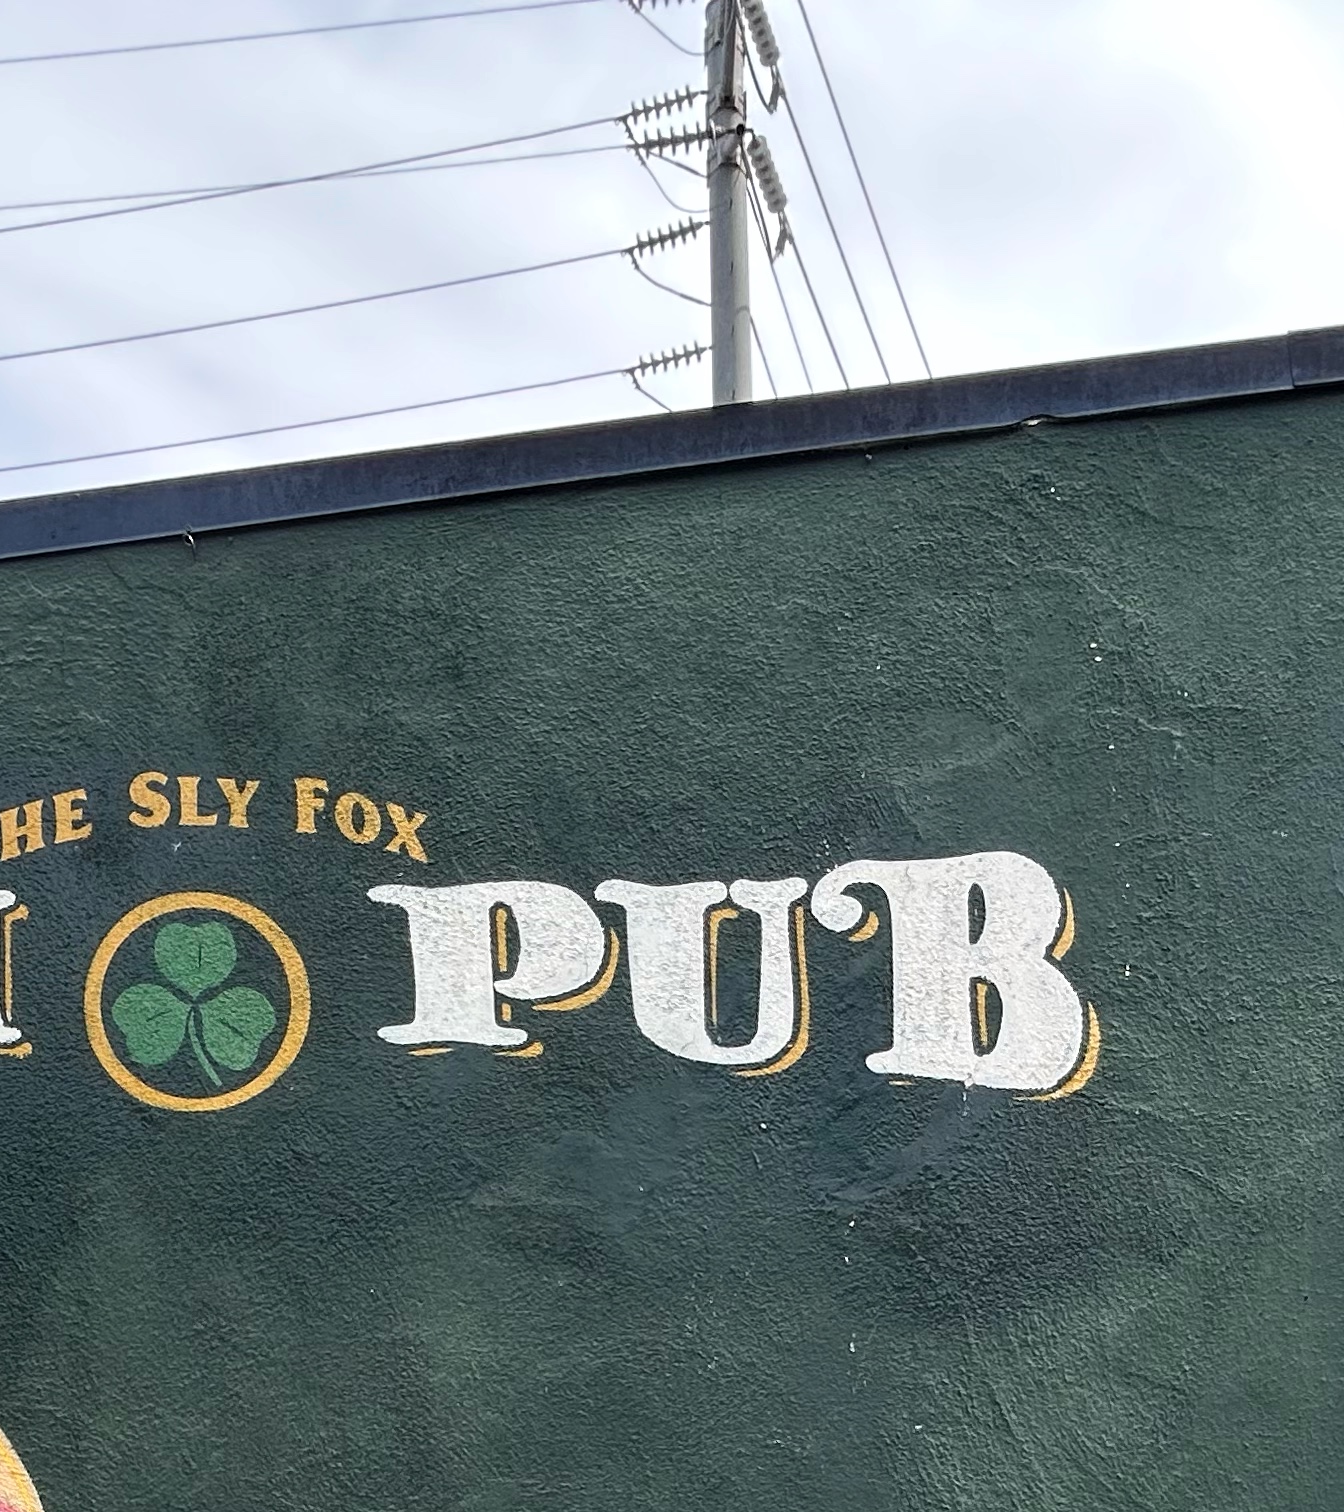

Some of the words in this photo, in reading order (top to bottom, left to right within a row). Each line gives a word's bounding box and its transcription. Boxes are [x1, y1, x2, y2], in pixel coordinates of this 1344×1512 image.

[128, 770, 261, 829] SLY
[293, 775, 430, 863] FOX
[365, 849, 1102, 1101] PUB
